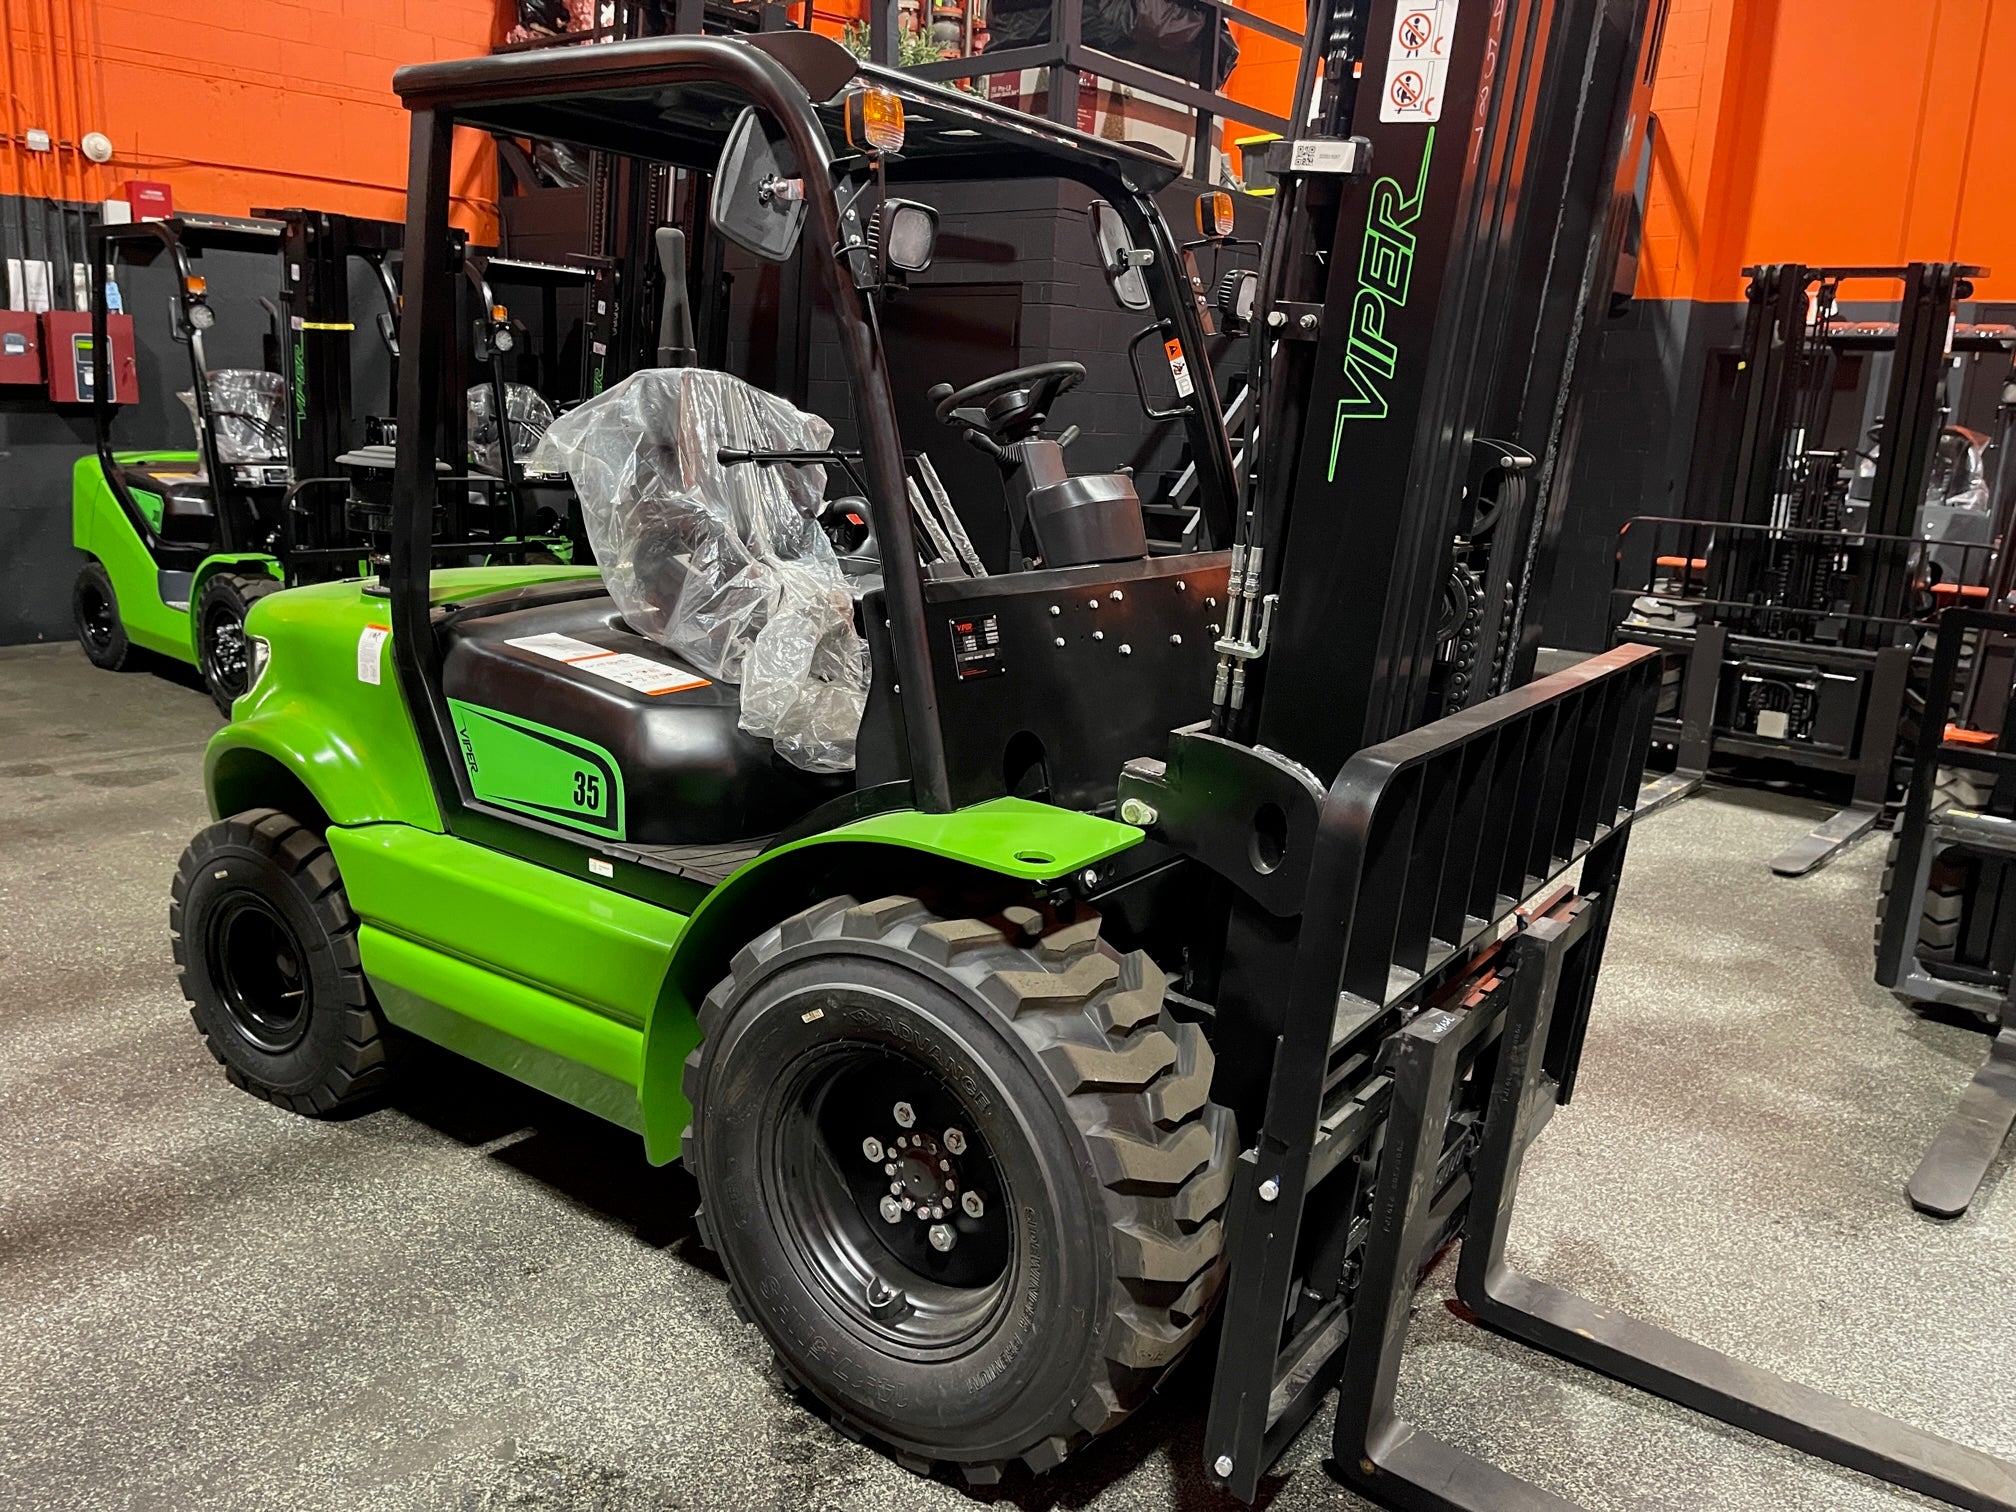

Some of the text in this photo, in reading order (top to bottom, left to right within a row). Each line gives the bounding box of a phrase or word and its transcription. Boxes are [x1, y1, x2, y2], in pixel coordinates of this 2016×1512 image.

[1327, 126, 1436, 482] VIPER
[459, 712, 479, 786] VIPER
[573, 770, 600, 811] 35
[879, 1014, 992, 1112] ADVANCE
